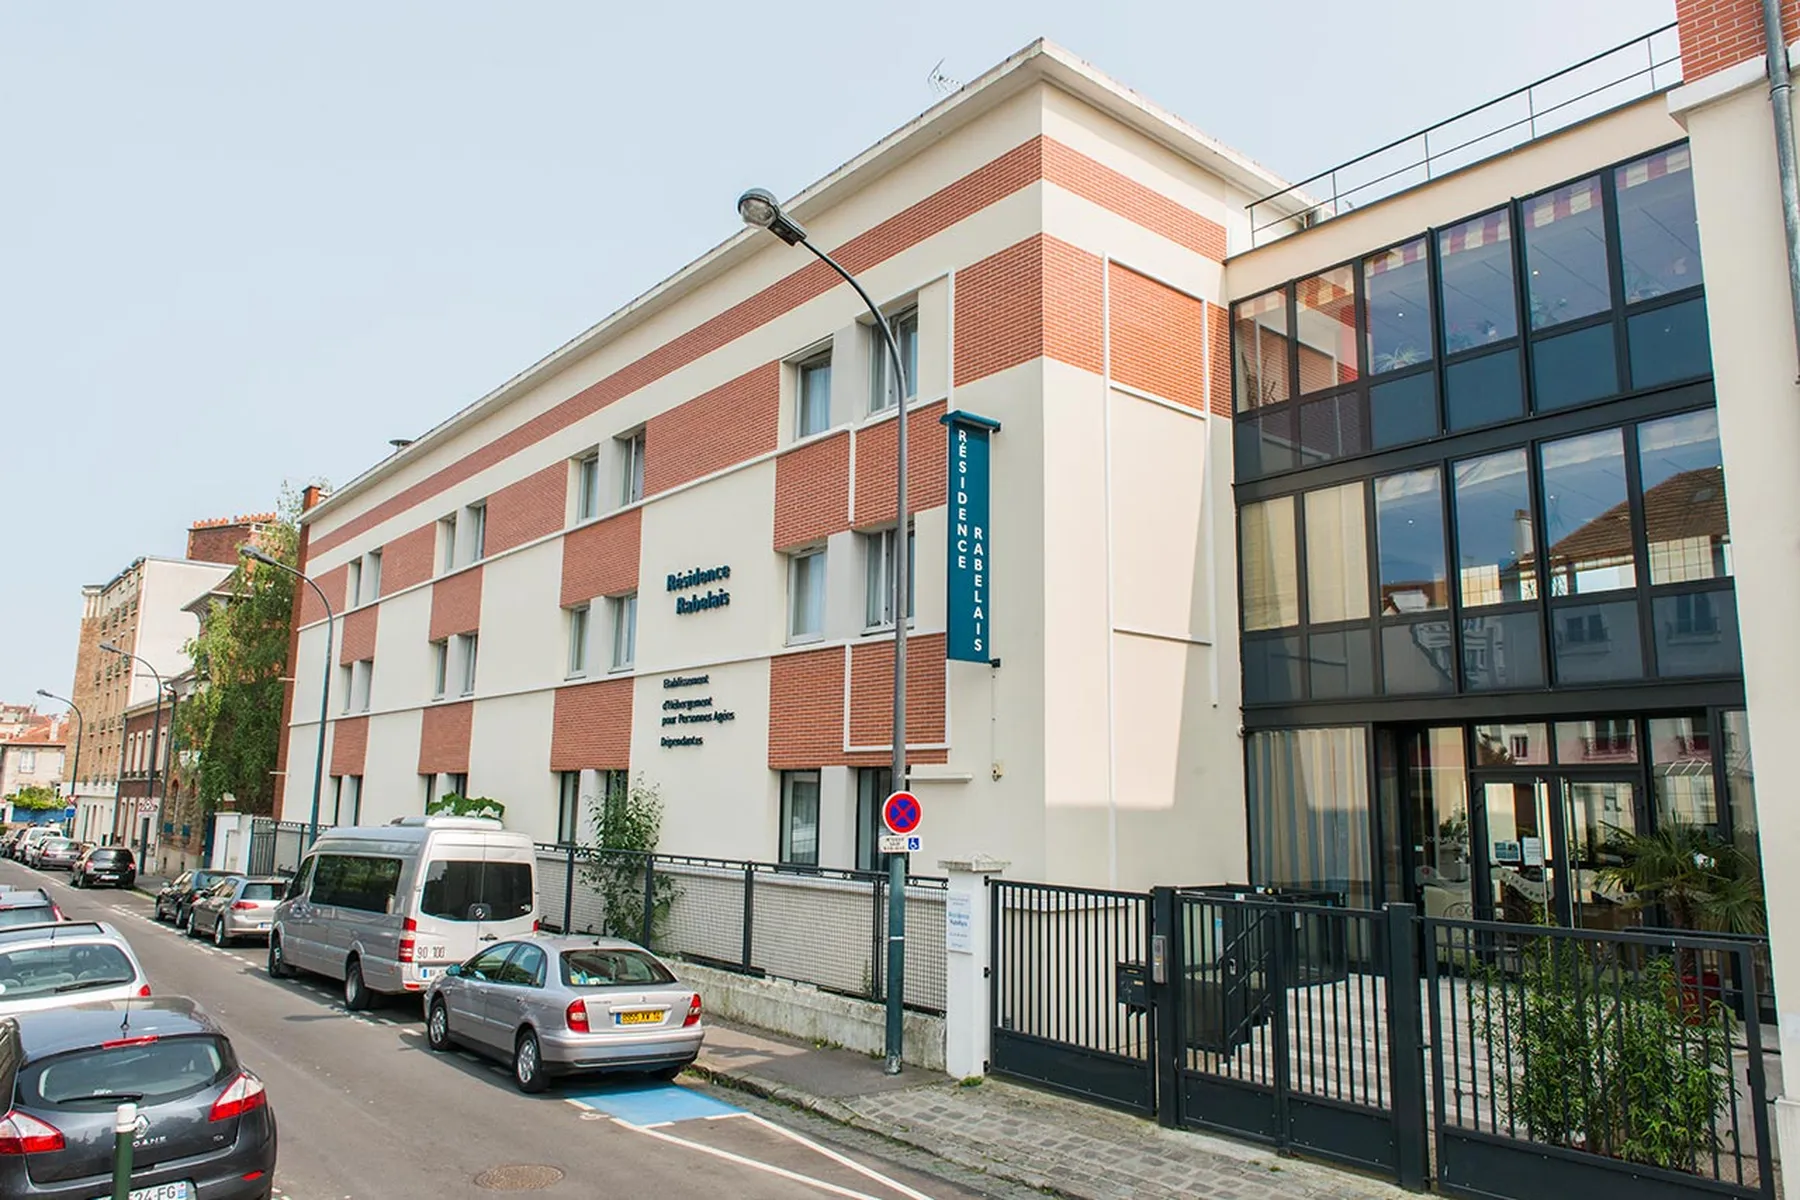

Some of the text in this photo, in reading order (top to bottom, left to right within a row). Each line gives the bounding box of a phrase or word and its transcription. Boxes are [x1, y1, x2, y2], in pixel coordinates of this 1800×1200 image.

[957, 430, 968, 569] RÉSIDENCE
[666, 565, 731, 592] Résidence
[973, 526, 984, 652] RABELAIS
[676, 588, 731, 615] Rabelais
[661, 716, 677, 727] pour
[678, 713, 712, 724] Personnes
[417, 946, 428, 959] 90
